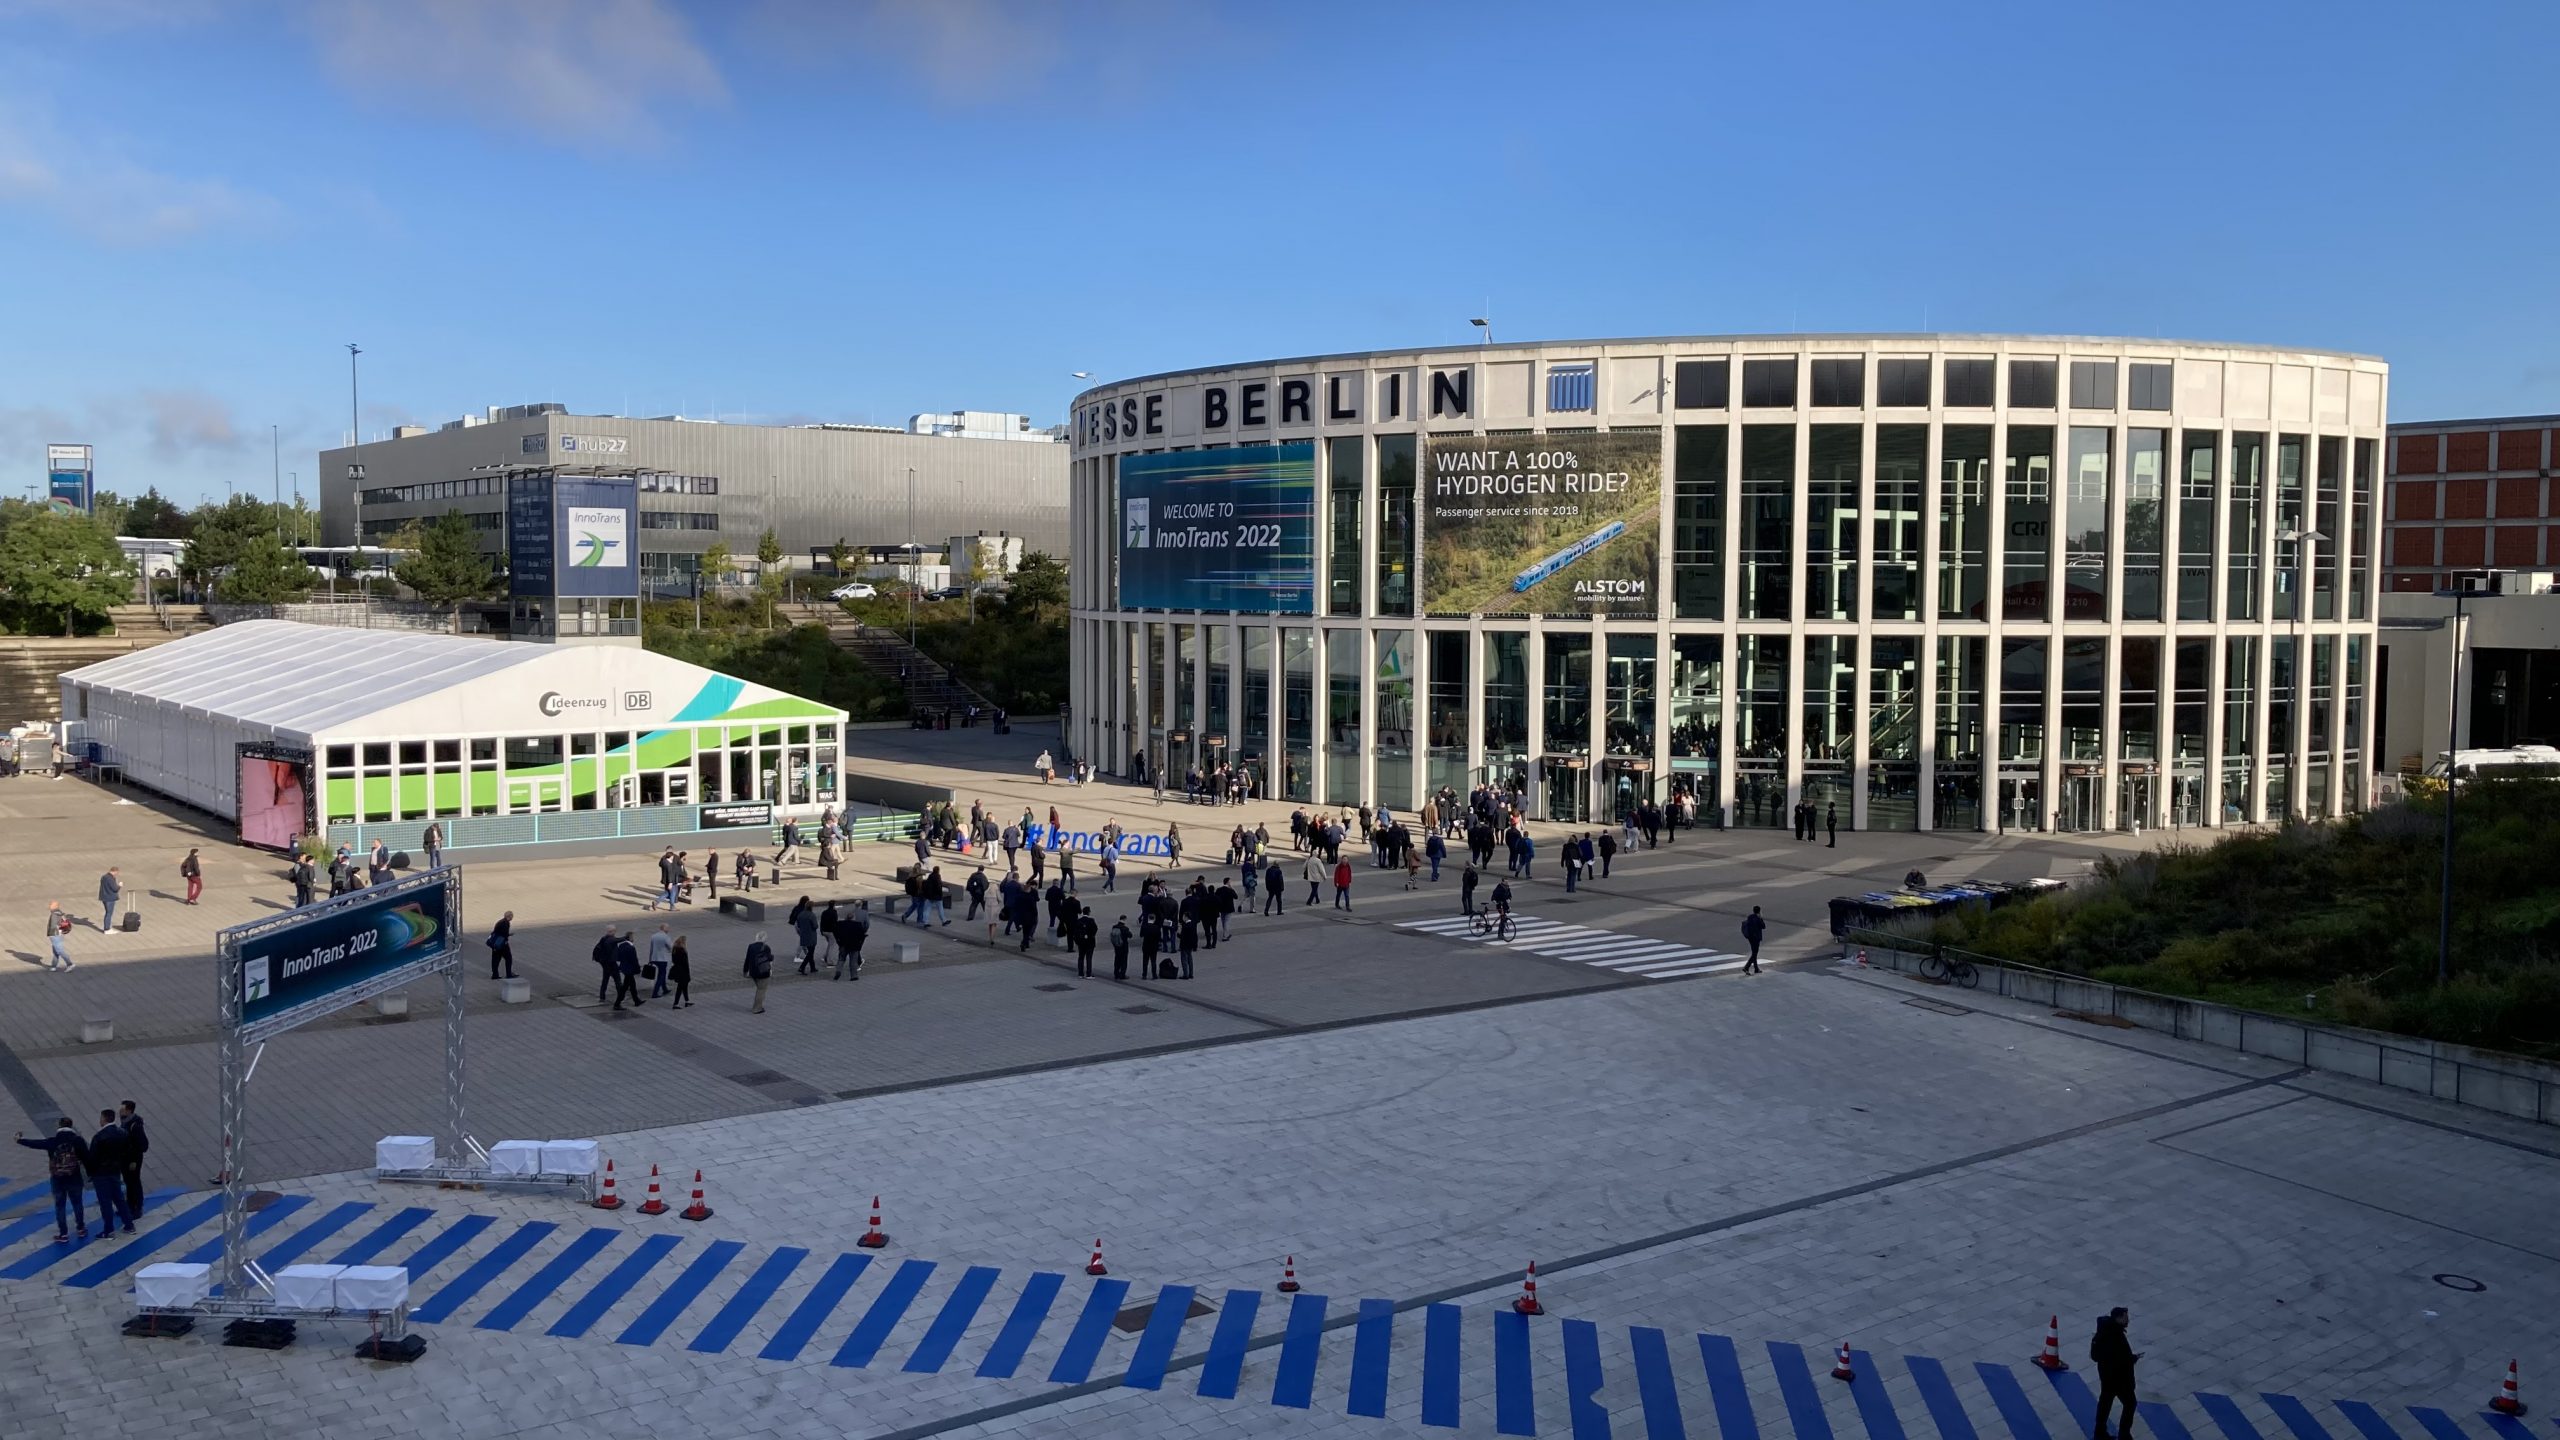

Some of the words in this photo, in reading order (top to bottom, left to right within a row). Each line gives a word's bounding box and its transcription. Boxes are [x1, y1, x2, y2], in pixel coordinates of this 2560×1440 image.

[1079, 395, 1162, 447] MESSE
[1205, 370, 1468, 428] BERLIN
[579, 437, 627, 452] hub27
[1436, 451, 1500, 471] WANT
[1505, 451, 1520, 470] A
[1526, 451, 1578, 470] 100%
[1437, 474, 1556, 496] HYDROGEN
[1565, 472, 1629, 493] RIDE?
[574, 512, 621, 524] InnoTrans
[1163, 503, 1215, 519] WELCOME
[1218, 502, 1234, 518] TO
[1435, 507, 1483, 519] Passenger
[1486, 505, 1520, 517] service
[1523, 504, 1549, 516] since
[1552, 505, 1579, 516] 2018
[1156, 526, 1229, 548] InnoTrans
[1235, 524, 1282, 547] 2022
[1574, 579, 1645, 593] ALSTOM
[1607, 595, 1616, 603] by
[552, 698, 607, 709] Ideenzug
[628, 694, 649, 708] DB
[1025, 823, 1172, 857] #Innorans
[282, 943, 345, 979] InnoTrans
[349, 928, 378, 955] 2022
